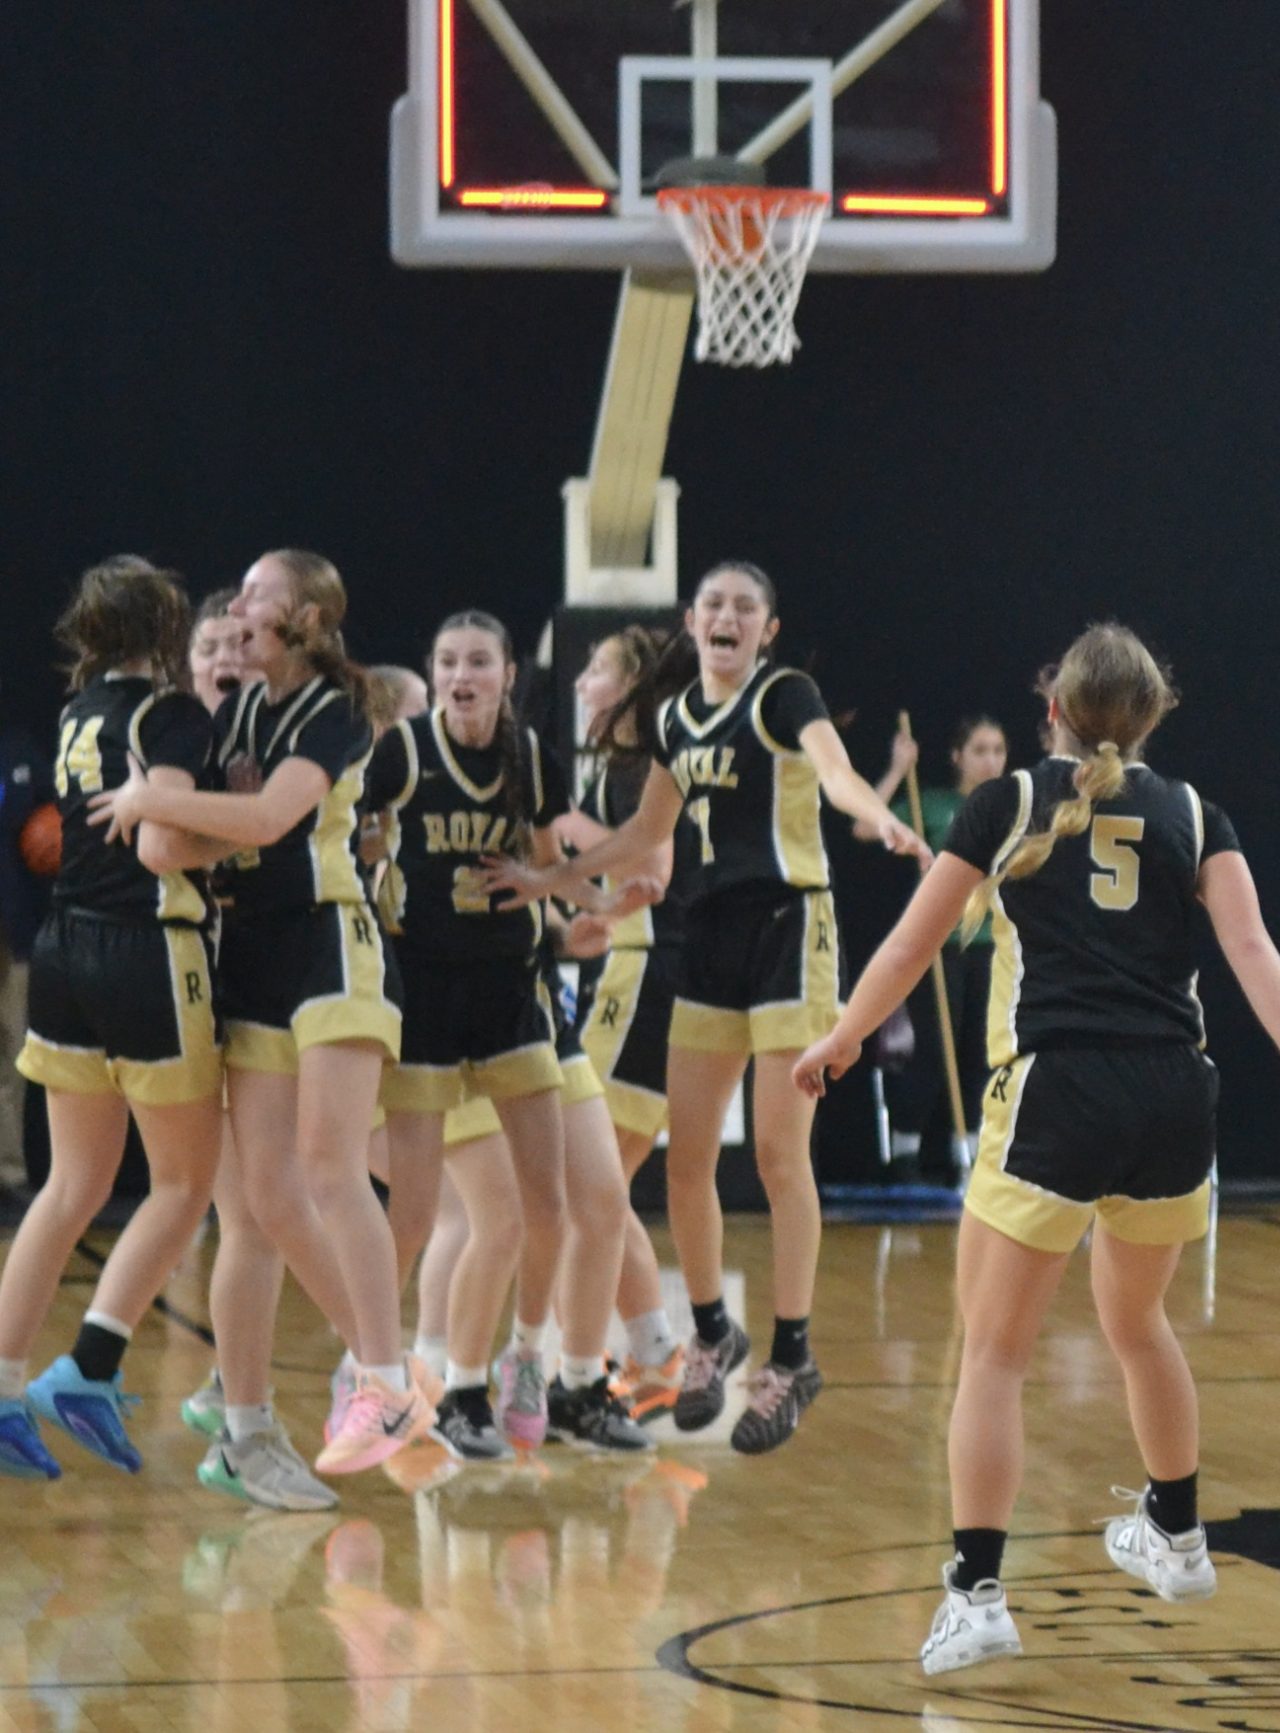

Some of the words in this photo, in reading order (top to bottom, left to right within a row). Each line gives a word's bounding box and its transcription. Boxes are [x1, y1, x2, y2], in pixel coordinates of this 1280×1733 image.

[55, 715, 105, 799] 14
[1090, 814, 1145, 911] 5
[353, 917, 373, 947] R
[184, 971, 204, 1004] R
[600, 996, 620, 1030] R
[990, 1065, 1013, 1103] R
